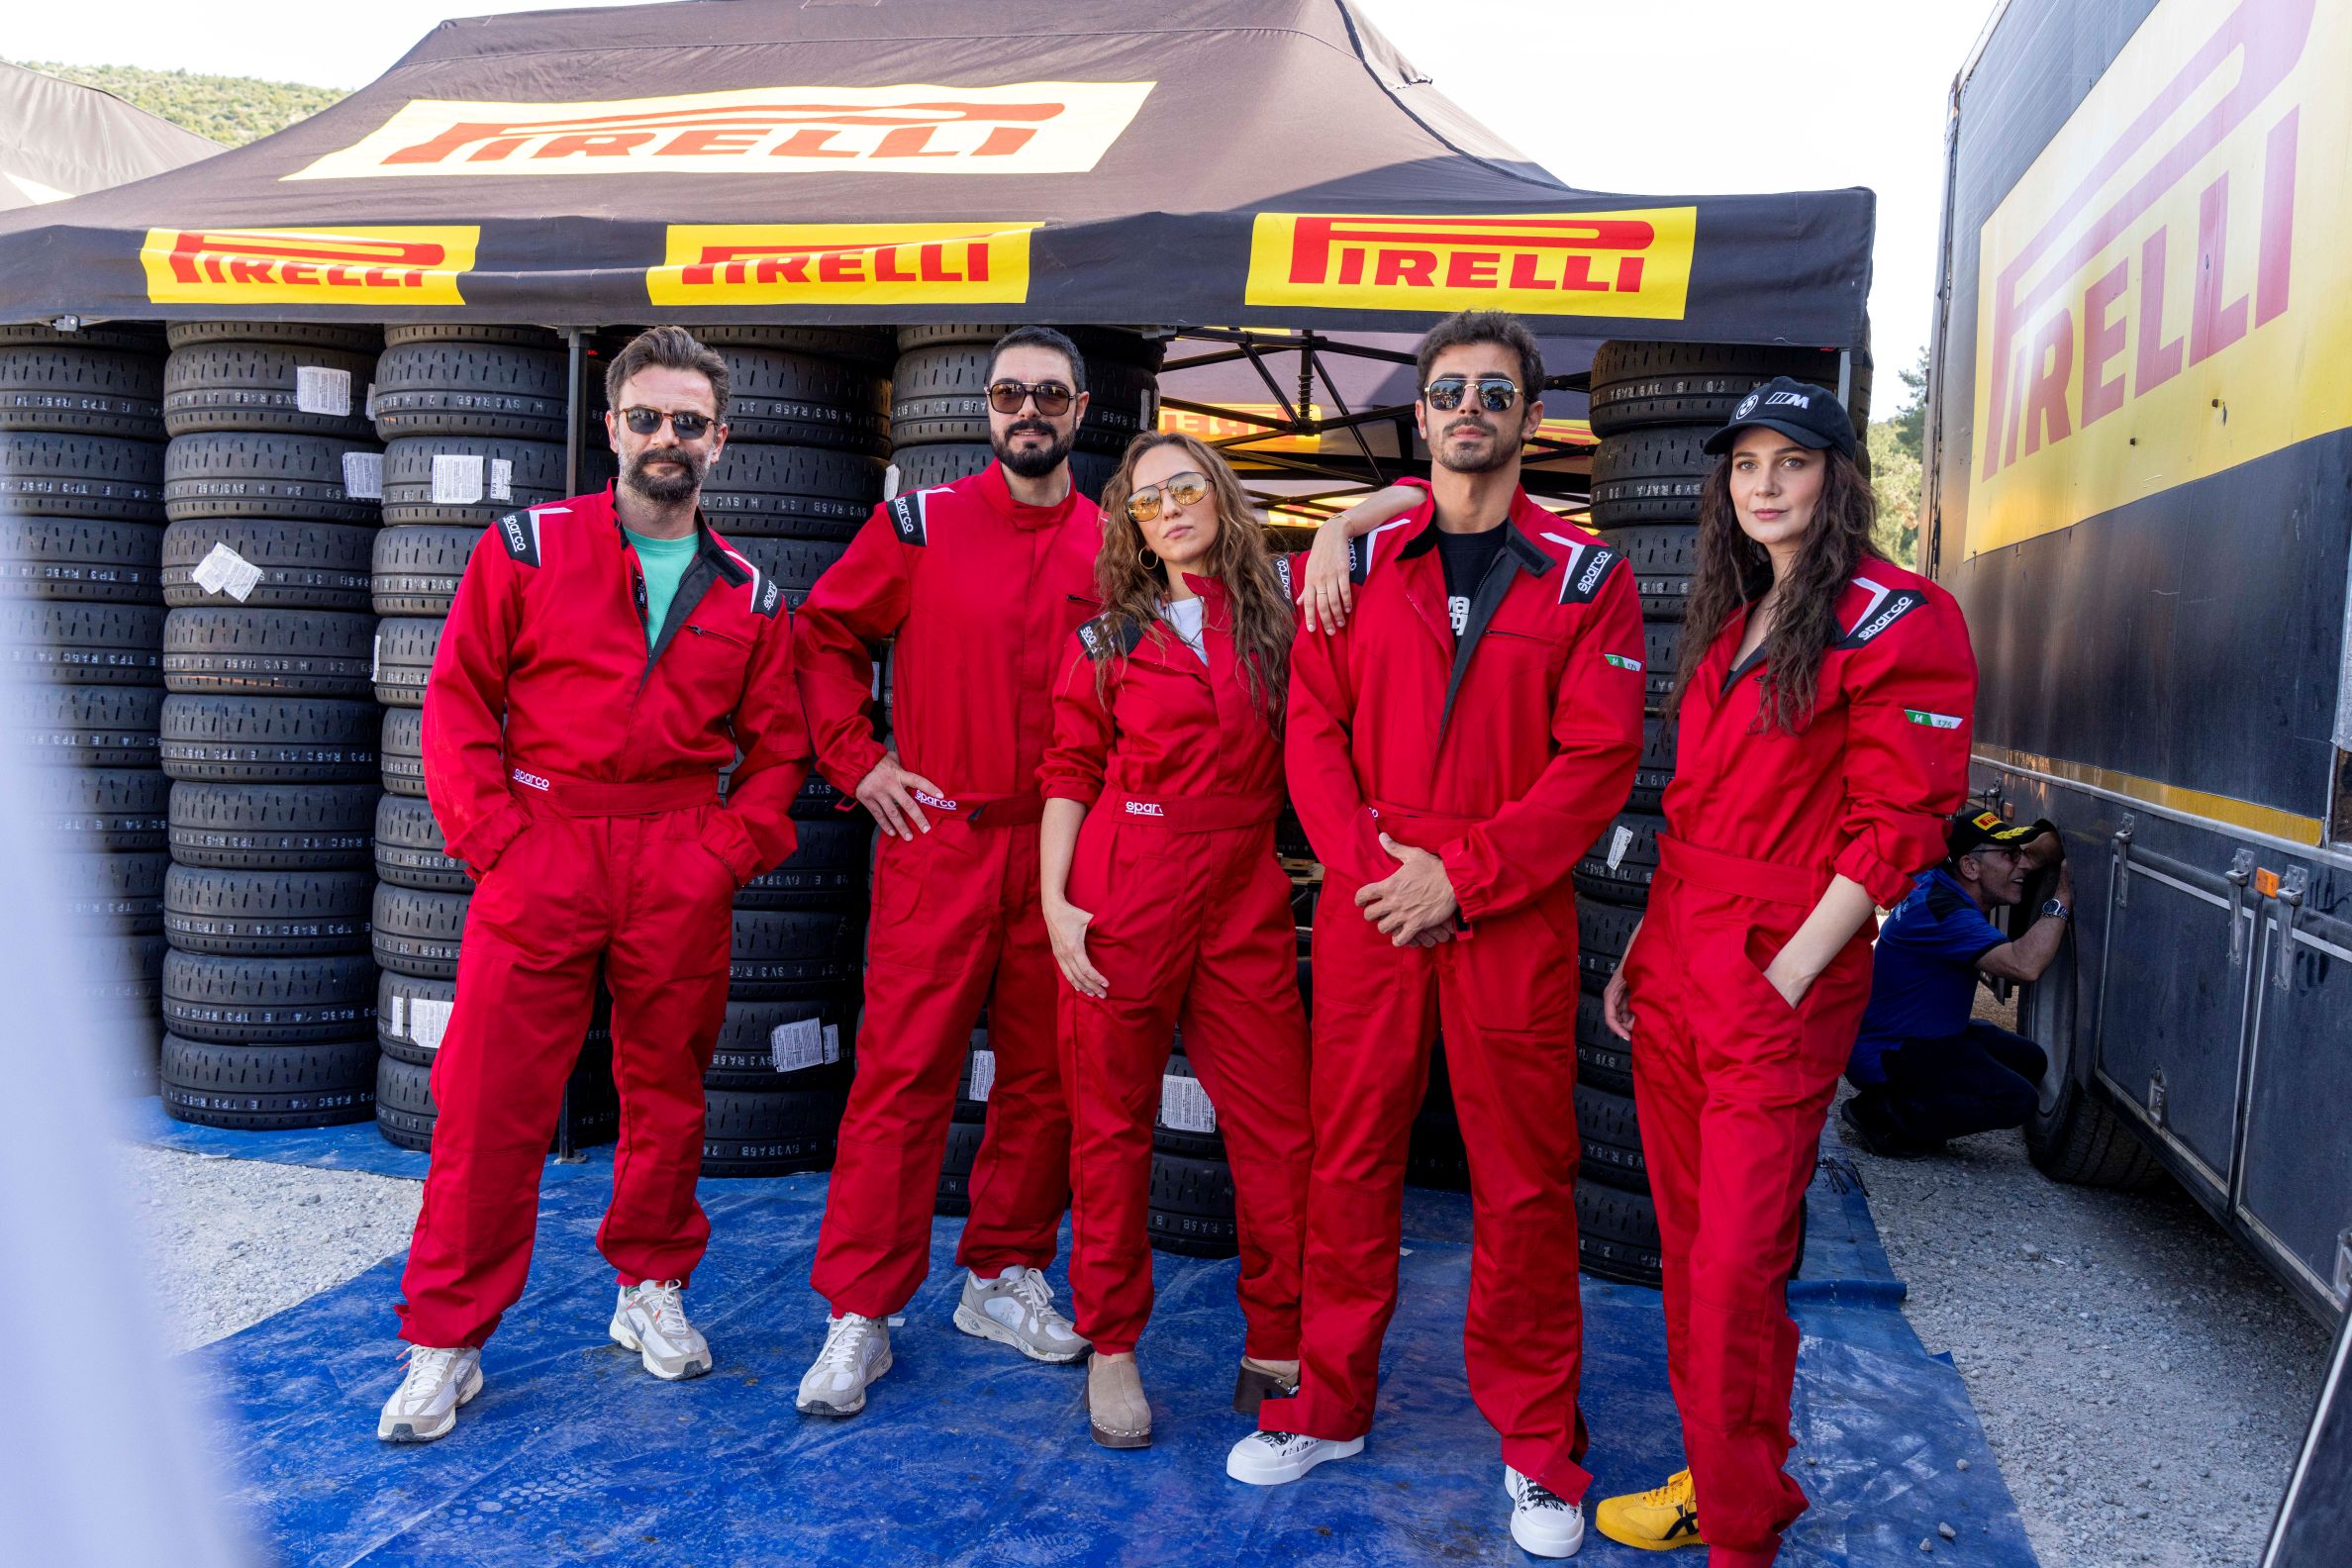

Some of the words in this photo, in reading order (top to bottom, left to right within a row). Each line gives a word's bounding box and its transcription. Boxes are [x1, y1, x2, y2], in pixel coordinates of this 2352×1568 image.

[379, 102, 1065, 164] PIRELLI
[1983, 0, 2316, 482] PIRELLI
[168, 233, 445, 288] PIRELLI
[1288, 217, 1655, 293] PIRELLI
[682, 245, 989, 285] PIRELLI
[235, 392, 265, 403] RA5B
[457, 396, 490, 407] RA5B
[496, 397, 520, 408] SV3
[82, 399, 108, 411] TP3
[775, 404, 808, 417] RA5B
[963, 400, 987, 413] A5B
[816, 408, 836, 420] SV3
[62, 483, 87, 494] TP3
[895, 497, 914, 534] parco
[503, 515, 526, 551] sparco
[90, 570, 116, 581] TP3
[1577, 551, 1612, 594] sparco
[431, 579, 452, 590] SV3
[1858, 597, 1912, 639] sparco
[63, 653, 98, 663] RA5C
[109, 654, 135, 665] TP3
[307, 751, 341, 760] RA5C
[513, 768, 550, 791] sparco
[915, 790, 957, 810] sparco
[227, 1013, 248, 1023] TP3
